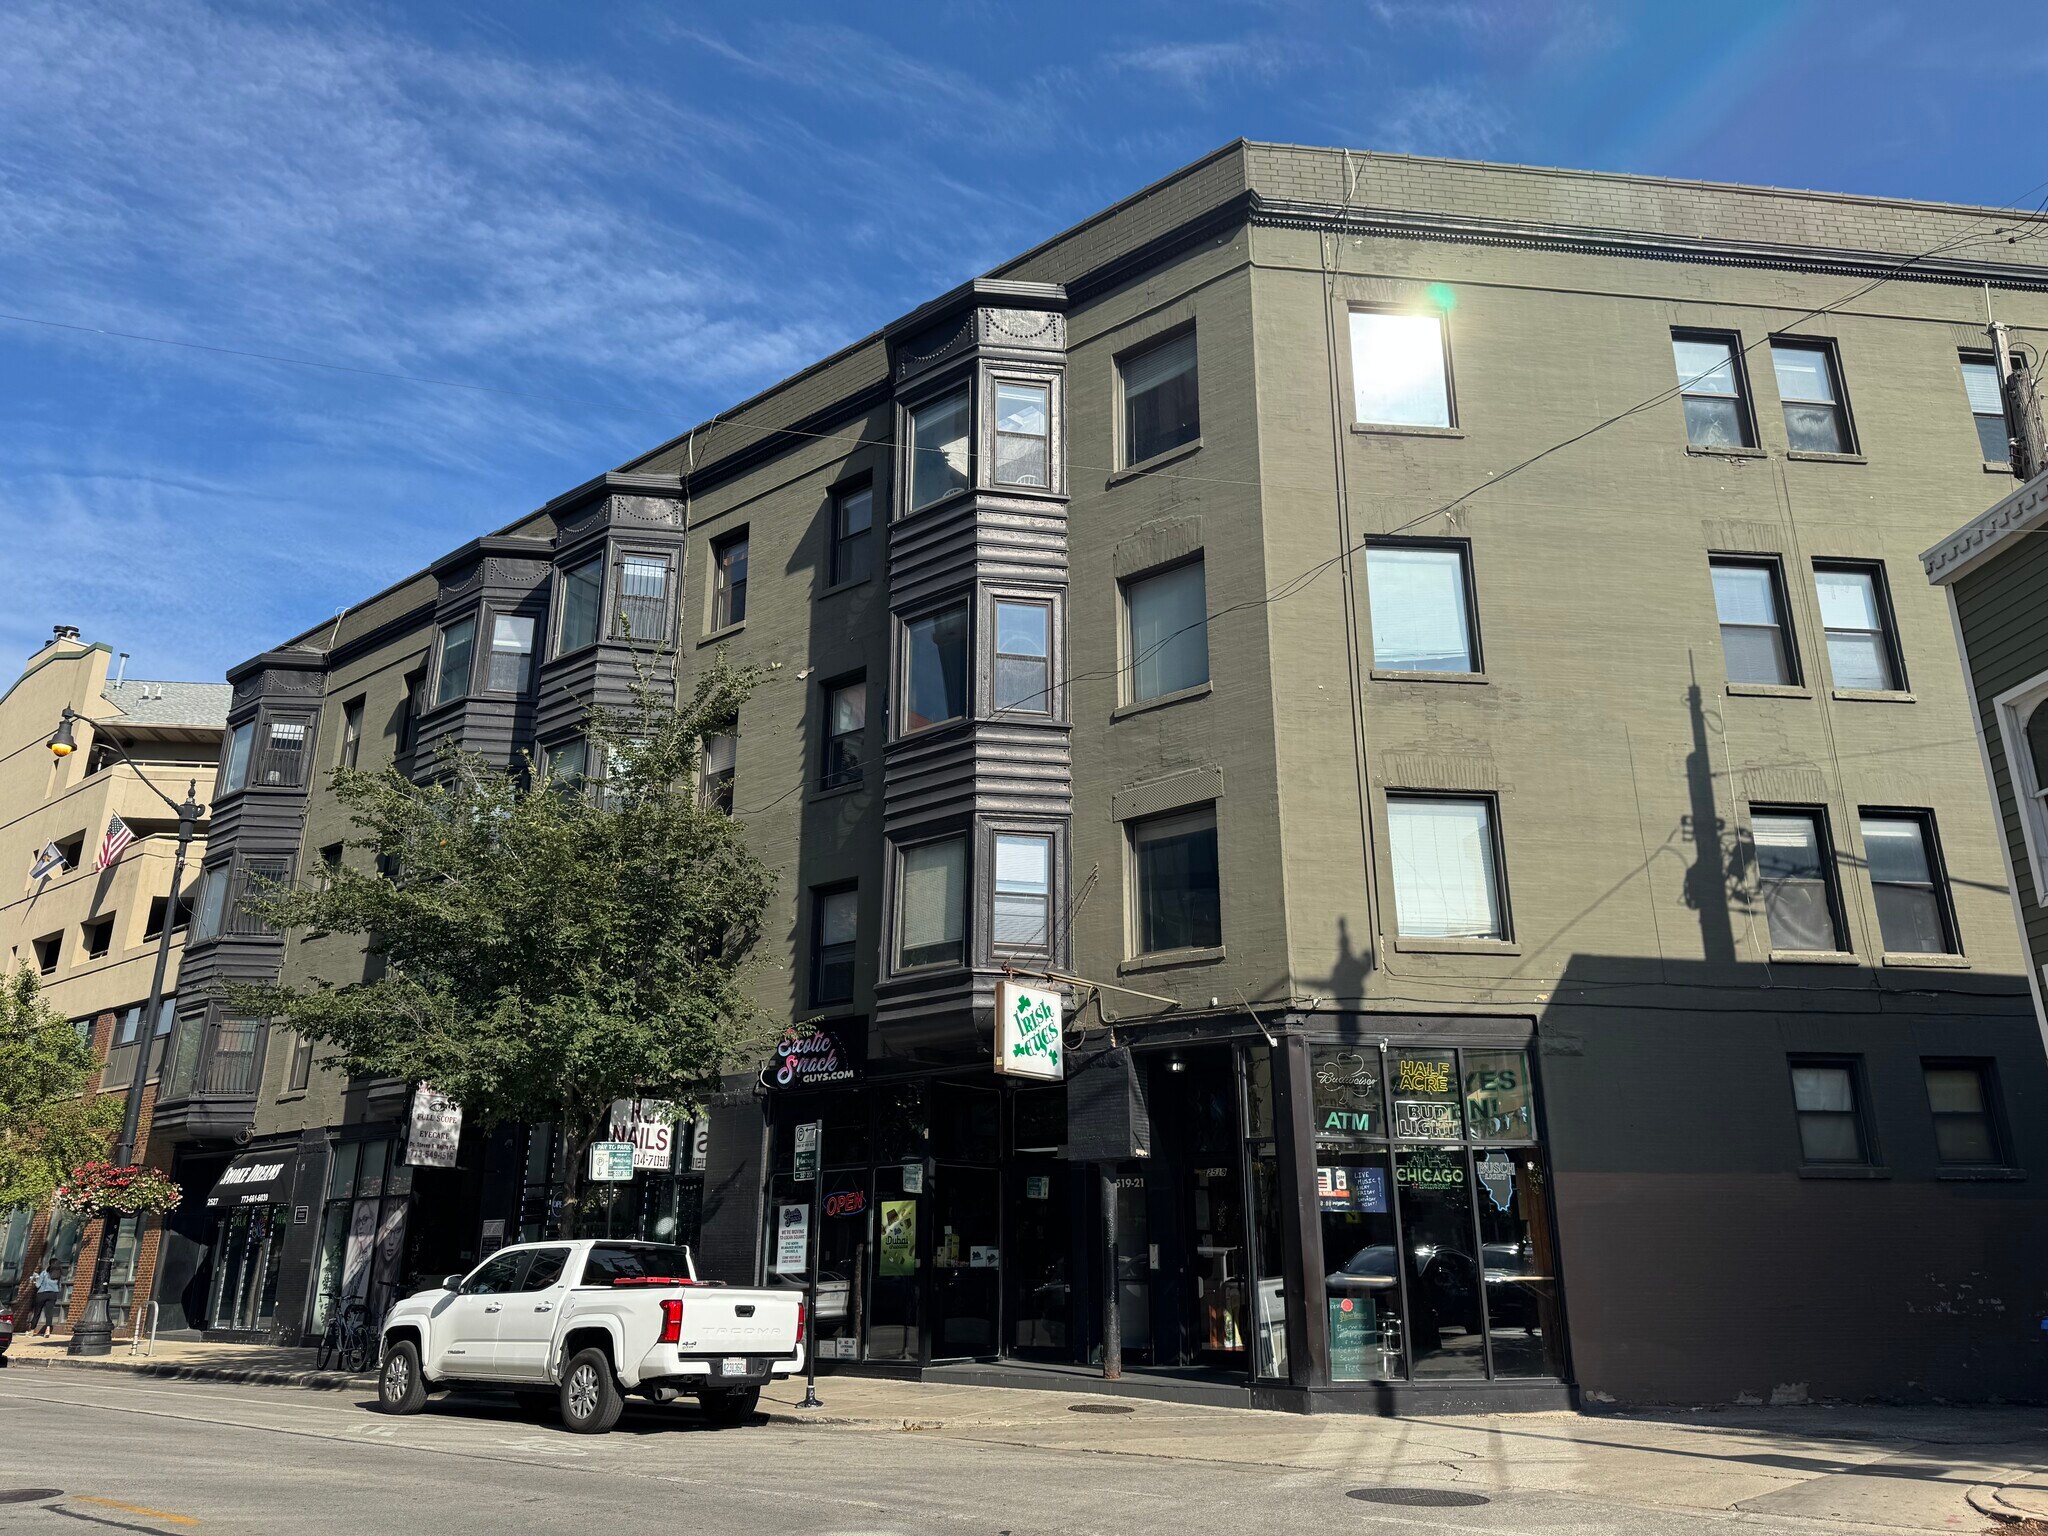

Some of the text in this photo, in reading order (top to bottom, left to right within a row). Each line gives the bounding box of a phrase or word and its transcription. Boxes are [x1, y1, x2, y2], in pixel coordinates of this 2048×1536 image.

[778, 1027, 832, 1057] Exotic
[777, 1049, 839, 1085] Snack
[1400, 1060, 1450, 1077] HALF
[802, 1070, 854, 1083] GUYS.COM
[1400, 1075, 1449, 1092] ACRE
[436, 1115, 457, 1124] SCOPE
[1407, 1105, 1448, 1120] BUD
[1324, 1111, 1370, 1131] ATM
[1399, 1118, 1456, 1136] LIGHT
[419, 1131, 450, 1140] EYECARE
[613, 1124, 668, 1151] NAILS
[220, 1164, 284, 1184] SMOKE DREAMS
[1354, 1171, 1370, 1179] LIVE
[1396, 1168, 1464, 1183] CHICAGO
[1476, 1161, 1516, 1176] BUSCH
[826, 1190, 864, 1216] OPEN
[885, 1235, 909, 1246] Dubai
[702, 1327, 781, 1335] TACOMA
